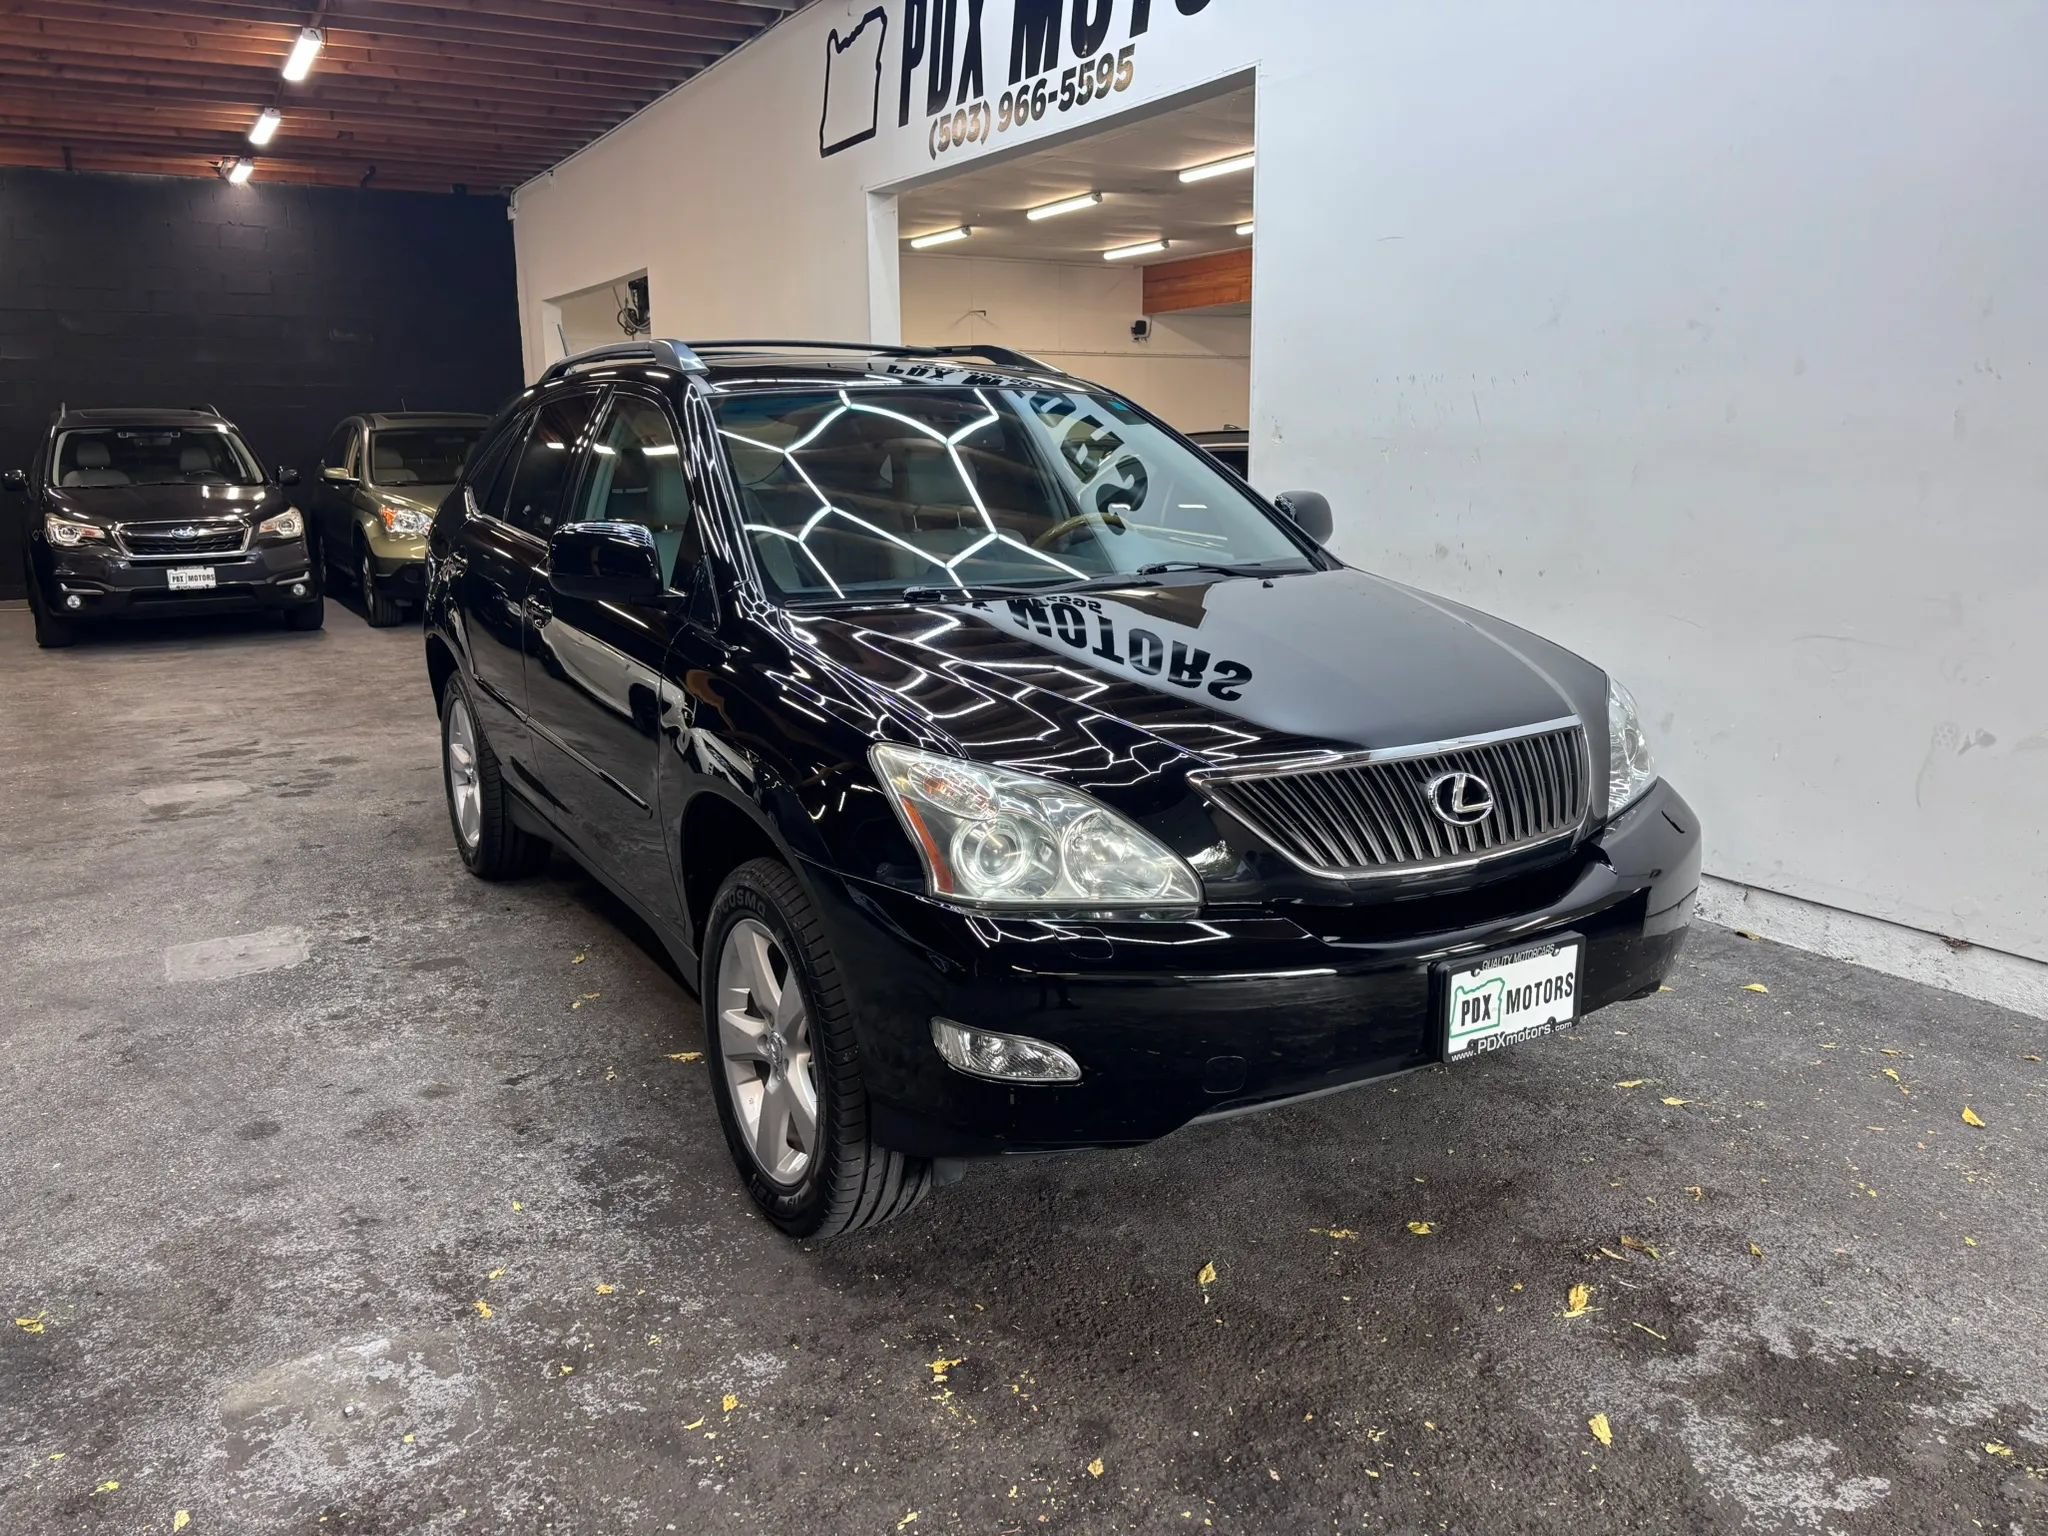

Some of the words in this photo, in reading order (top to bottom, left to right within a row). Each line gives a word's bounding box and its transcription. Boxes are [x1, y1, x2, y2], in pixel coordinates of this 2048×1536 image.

[899, 0, 983, 127] PDX
[929, 101, 990, 160] (503)
[998, 44, 1136, 132] 966-5595
[1482, 955, 1512, 970] QUALITY
[1513, 944, 1555, 963] MOTORCARS
[1461, 993, 1492, 1026] PDX
[1505, 972, 1574, 1015] MOTORS
[1451, 1021, 1572, 1062] www.PDXmotors.com
